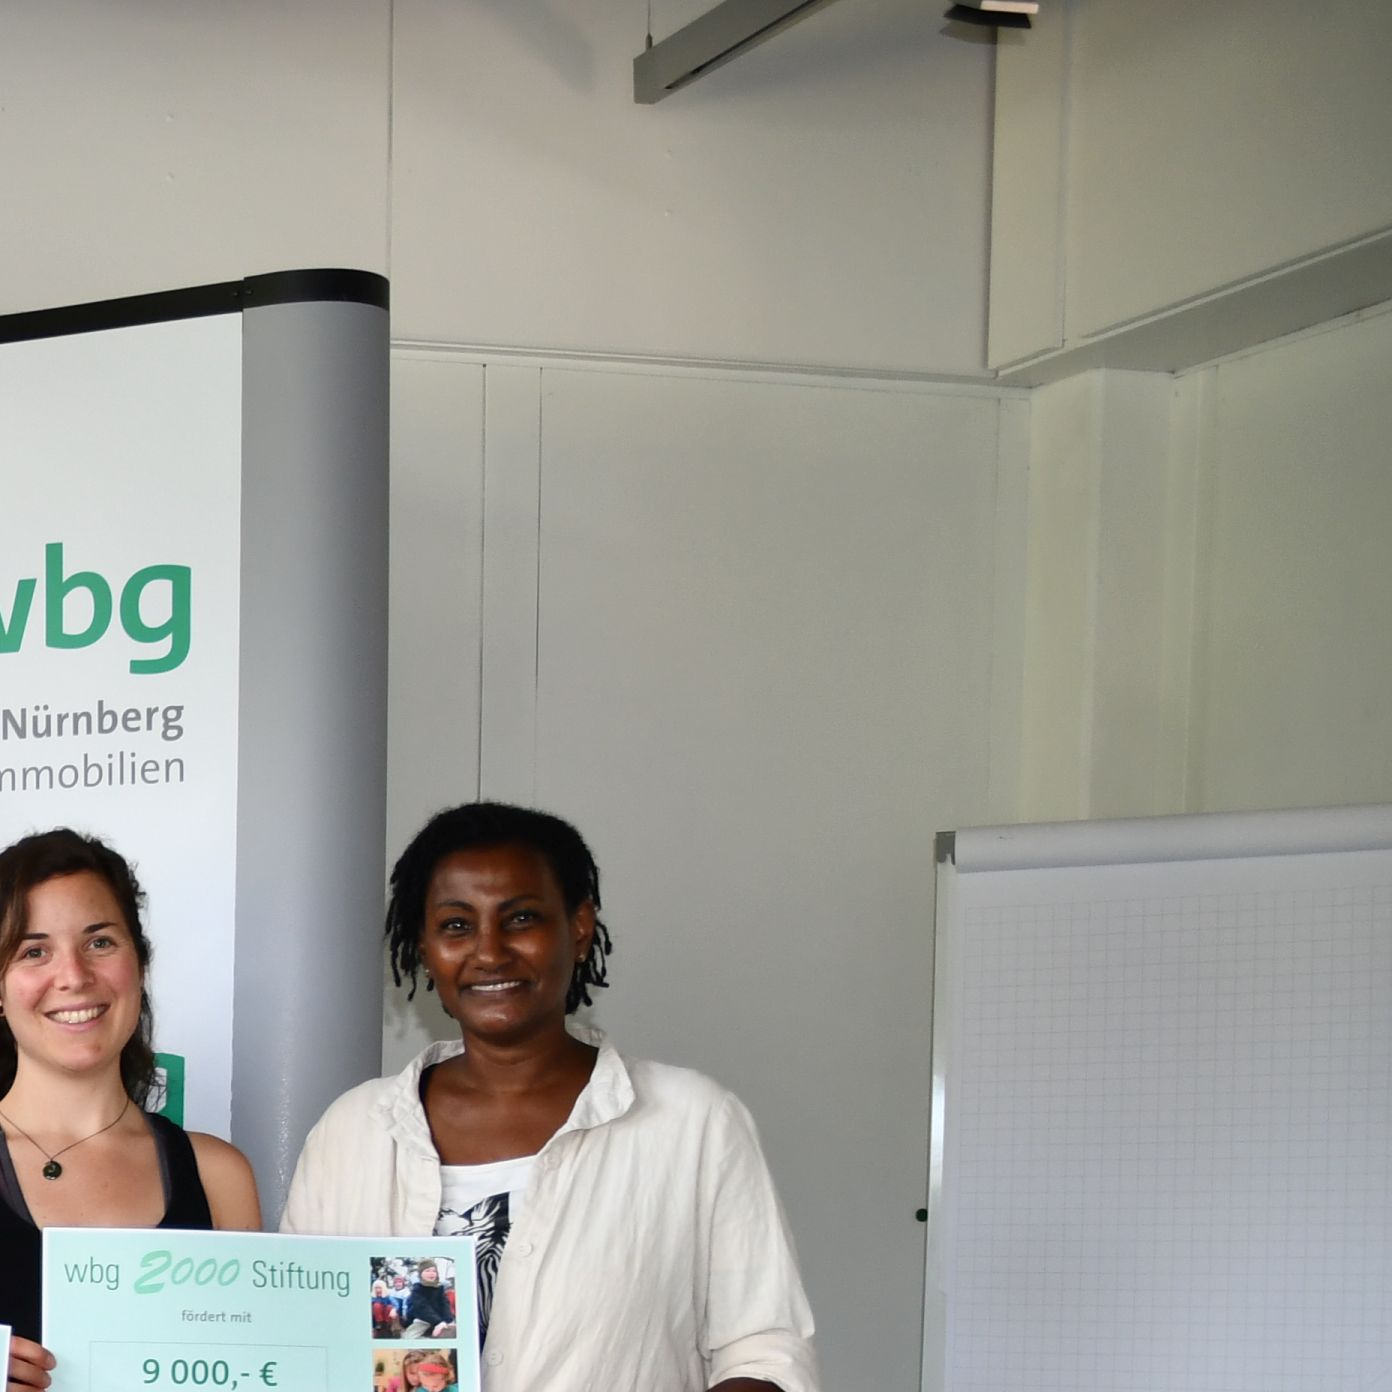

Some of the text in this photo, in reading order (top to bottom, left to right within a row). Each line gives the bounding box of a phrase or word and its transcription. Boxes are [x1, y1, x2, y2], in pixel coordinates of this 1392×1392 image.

[1, 700, 184, 740] Nürnberg
[64, 1250, 351, 1297] wbg 2000 Stiftung
[182, 1310, 252, 1323] fördert mit
[143, 1359, 277, 1390] 9 000,- €
